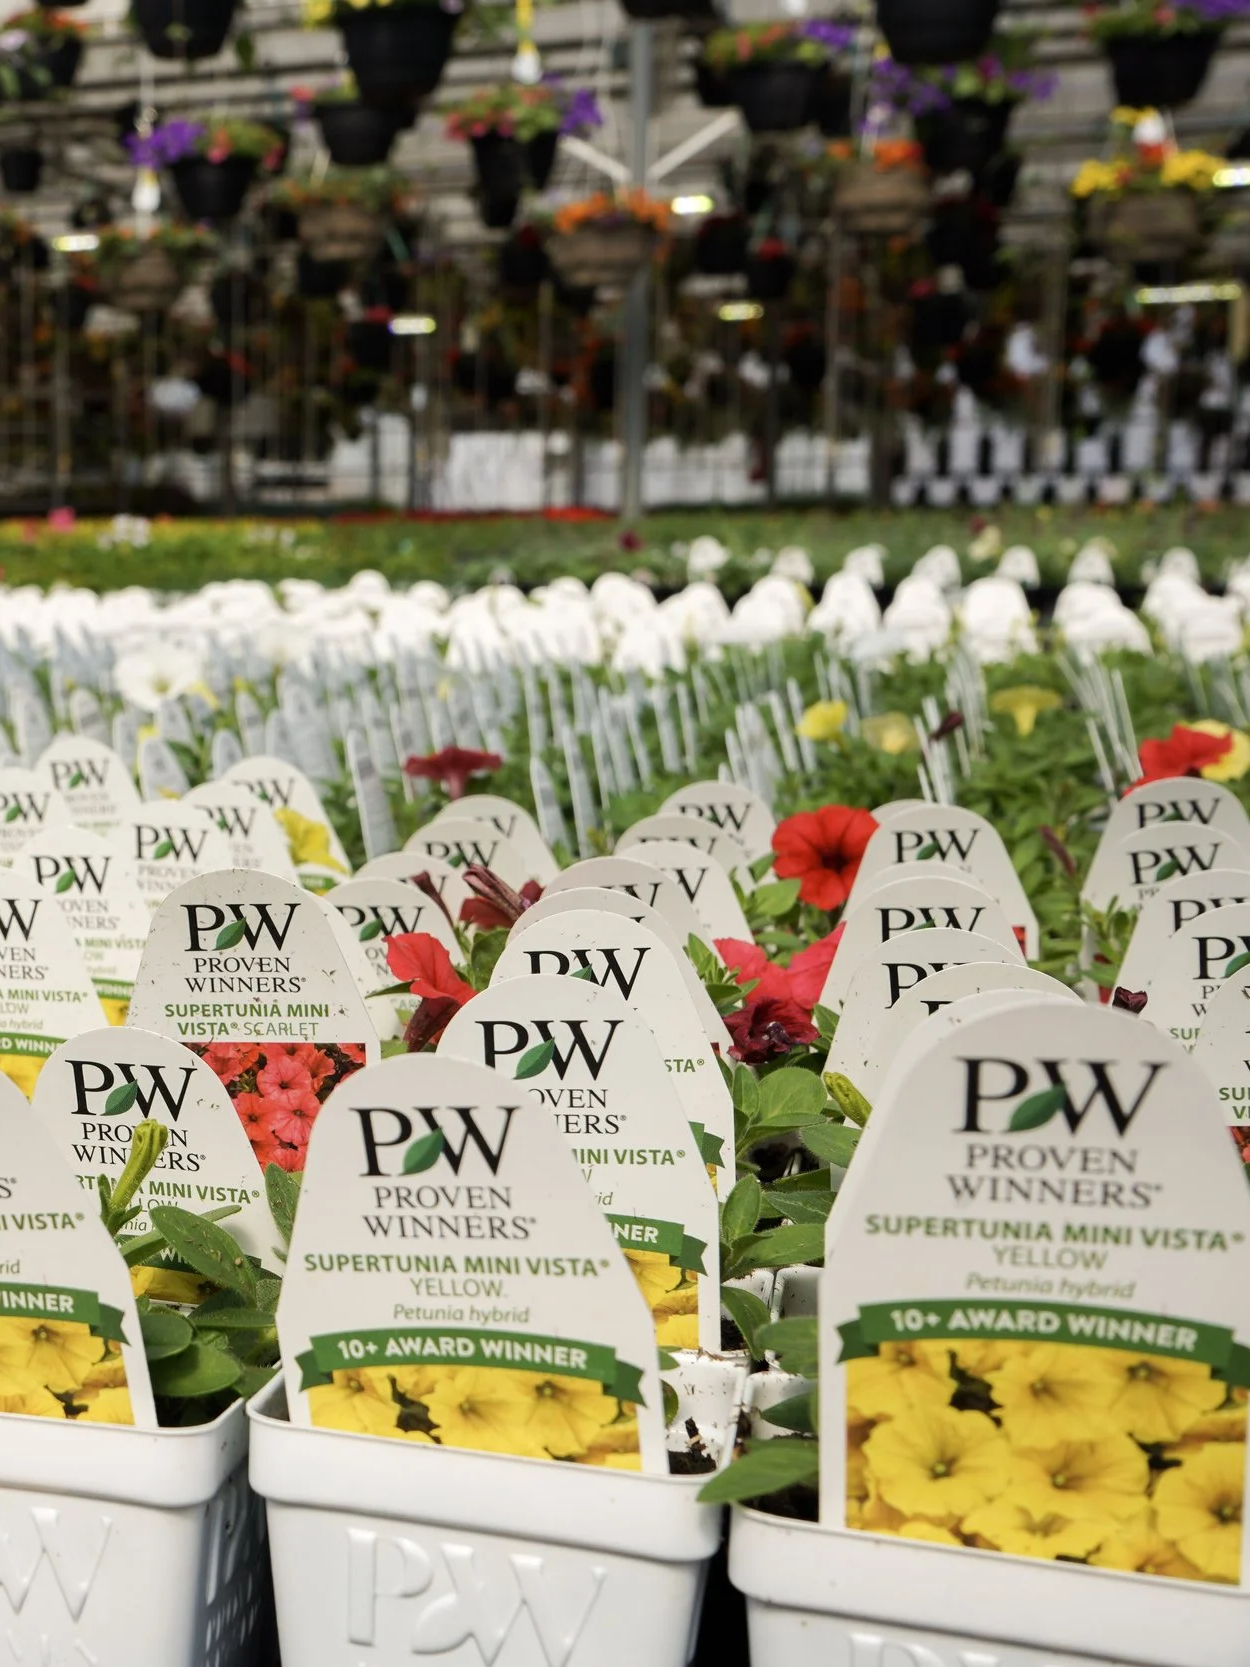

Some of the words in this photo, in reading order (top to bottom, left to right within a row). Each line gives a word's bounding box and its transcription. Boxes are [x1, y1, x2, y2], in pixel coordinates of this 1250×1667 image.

[51, 758, 110, 790] PW
[135, 826, 208, 863] PW
[892, 828, 981, 864] PW
[33, 856, 112, 894] PW
[1127, 842, 1223, 884] PW
[180, 902, 301, 951] PW
[194, 957, 291, 973] PROVEN
[8, 988, 39, 1001] MINI
[165, 1003, 280, 1018] SUPERTUNIA
[287, 1004, 329, 1018] MINI
[8, 1018, 44, 1030] hybrid
[244, 1022, 319, 1036] SCARLET
[475, 1020, 624, 1081] PW
[65, 1059, 198, 1122] PW
[952, 1055, 1171, 1139] PW
[348, 1106, 521, 1178] PW
[966, 1142, 1139, 1176] PROVEN
[149, 1181, 193, 1199] MINI
[372, 1185, 513, 1210] PROVEN
[865, 1214, 1054, 1243] SUPERTUNIA
[1062, 1223, 1132, 1247] MINI
[304, 1254, 458, 1275] SUPERTUNIA
[464, 1256, 520, 1275] MINI
[991, 1244, 1109, 1272] YELLOW
[410, 1278, 504, 1298] YELLOW
[964, 1272, 1053, 1295] Petunia
[1059, 1278, 1136, 1302] hybrid
[393, 1304, 464, 1322] Petunia
[469, 1304, 530, 1326] hybrid
[890, 1308, 941, 1332] 10+
[948, 1308, 1061, 1335] AWARD
[1066, 1312, 1199, 1352] WINNER
[337, 1339, 378, 1360] 10+
[385, 1336, 475, 1359] AWARD
[480, 1337, 588, 1370] WINNER
